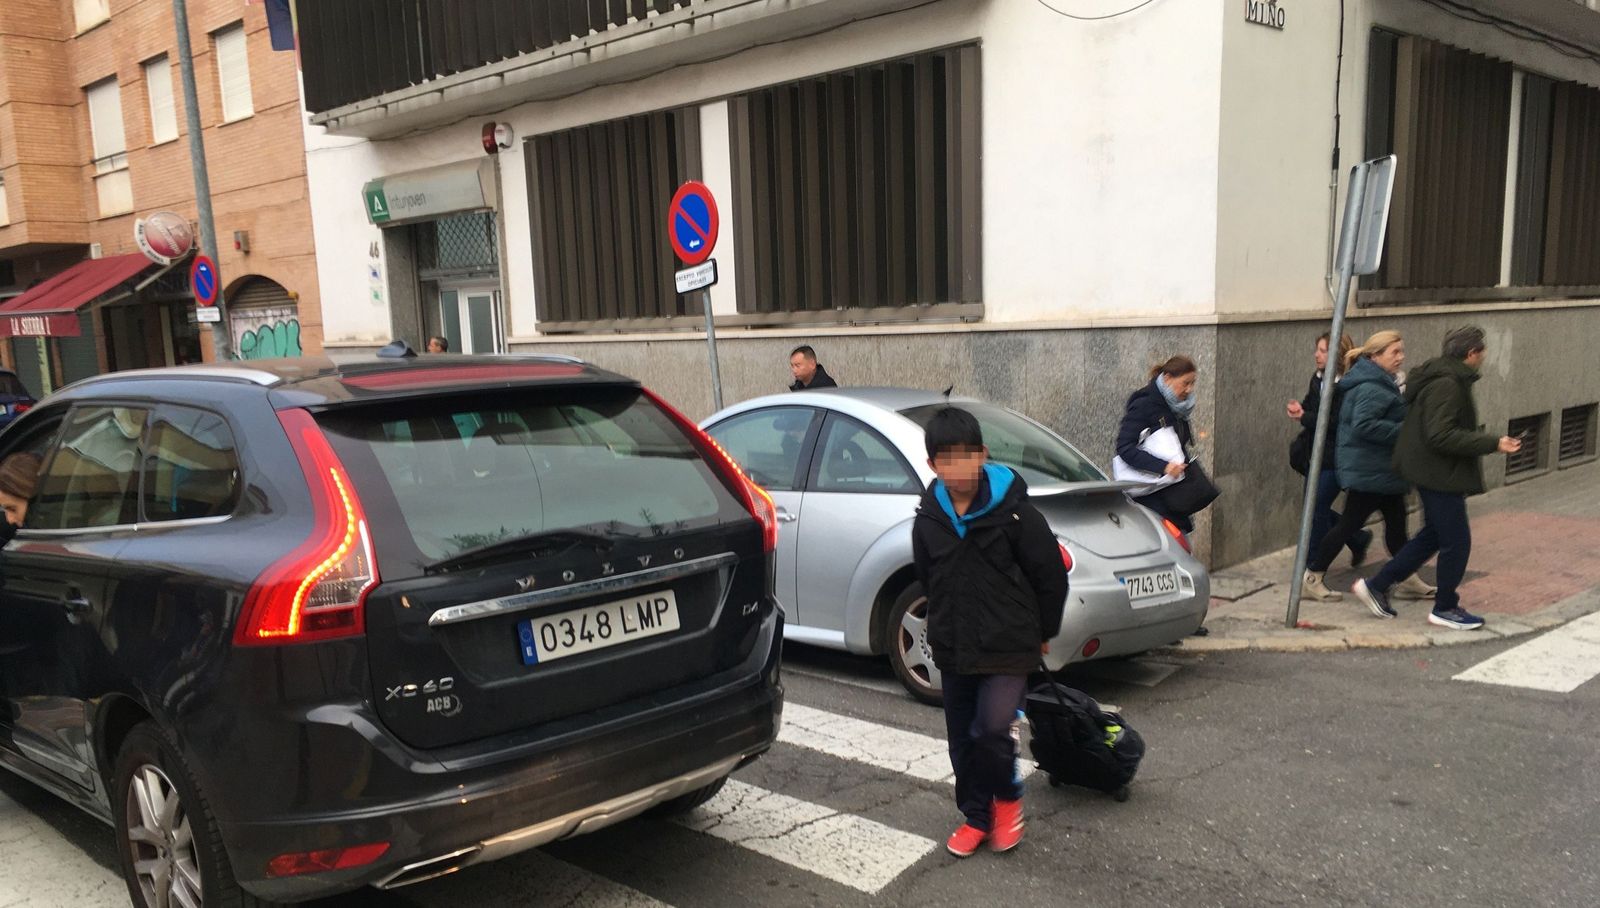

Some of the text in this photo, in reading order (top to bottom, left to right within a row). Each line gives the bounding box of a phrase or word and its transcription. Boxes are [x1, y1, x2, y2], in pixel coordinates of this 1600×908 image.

[369, 241, 380, 259] 46
[515, 547, 685, 593] VOLVO
[1127, 572, 1175, 597] 7743 CCS
[540, 597, 670, 652] 0348 LMP
[426, 695, 452, 713] ACB
